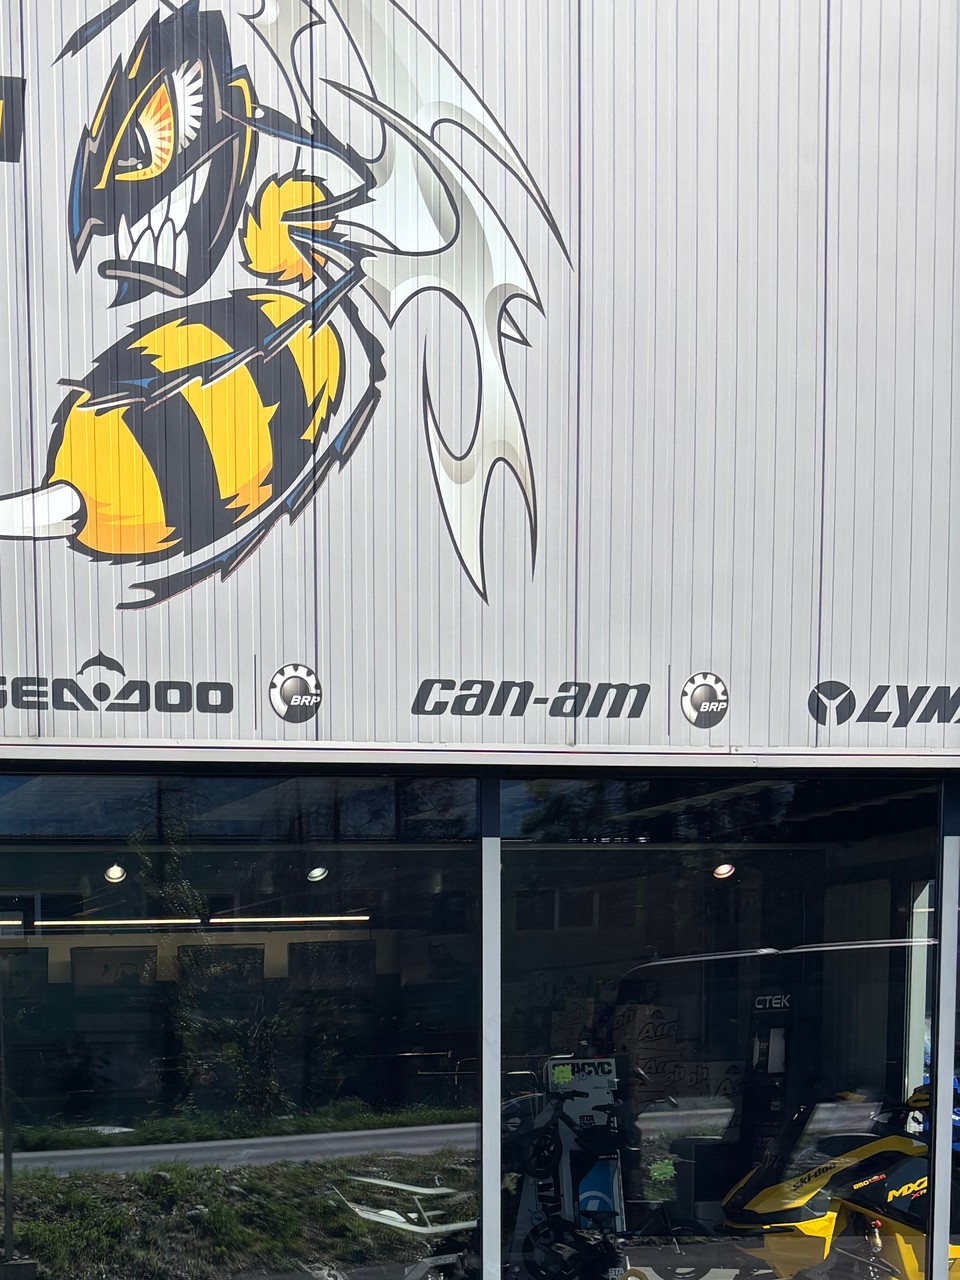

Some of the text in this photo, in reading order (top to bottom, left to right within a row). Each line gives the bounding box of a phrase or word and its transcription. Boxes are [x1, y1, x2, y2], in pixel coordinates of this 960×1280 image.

[290, 694, 321, 707] BRP
[411, 678, 651, 719] can-am
[855, 684, 960, 728] LYN
[699, 702, 728, 713] BRP
[754, 994, 791, 1009] CTEK
